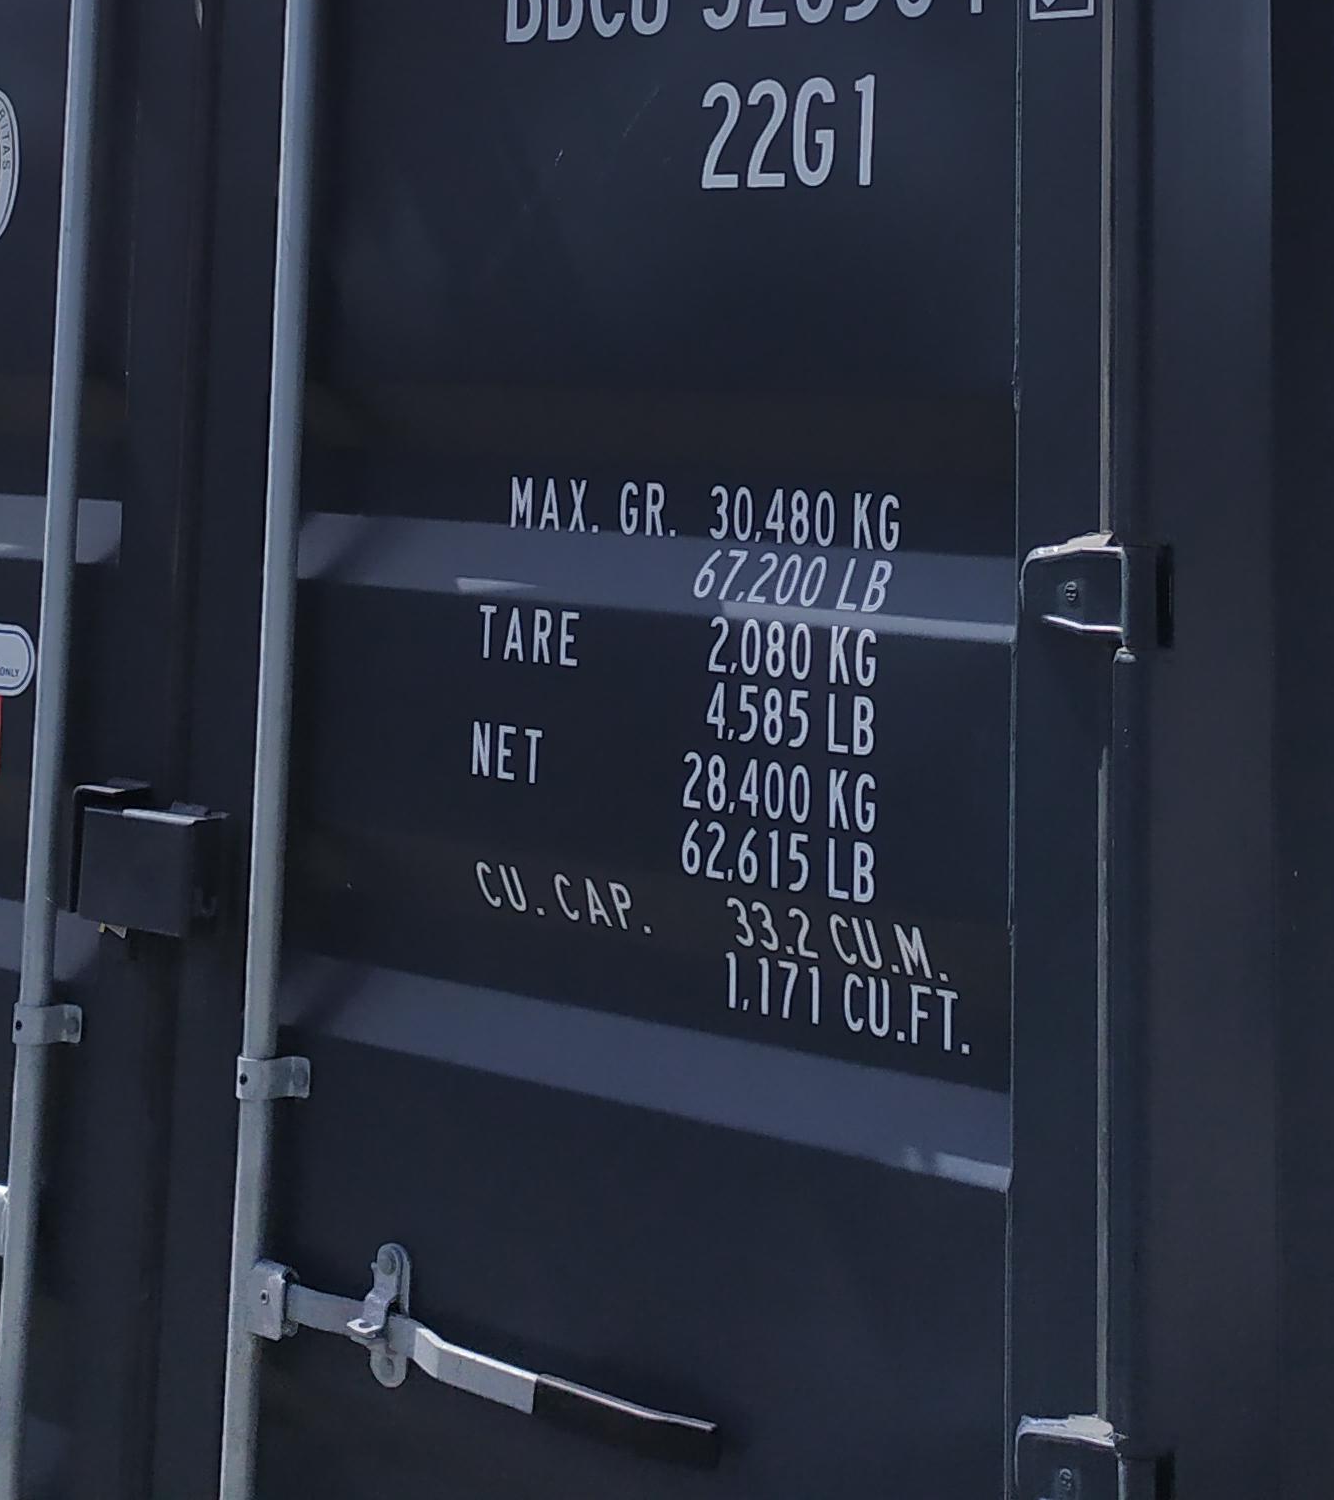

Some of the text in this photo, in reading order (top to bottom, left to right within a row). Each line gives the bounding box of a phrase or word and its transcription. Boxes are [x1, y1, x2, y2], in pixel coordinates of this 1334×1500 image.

[701, 73, 875, 189] 22G1
[510, 476, 599, 533] MAX.
[620, 481, 676, 537] GR.
[853, 493, 900, 551] KG
[835, 558, 893, 613] LB
[0, 666, 20, 678] ONLY
[479, 605, 580, 667] TARE
[829, 625, 877, 687] KG
[828, 693, 874, 756] LB
[471, 721, 543, 784] NET
[829, 768, 876, 833] KG
[828, 837, 875, 902] LB
[727, 897, 819, 959] 33.2
